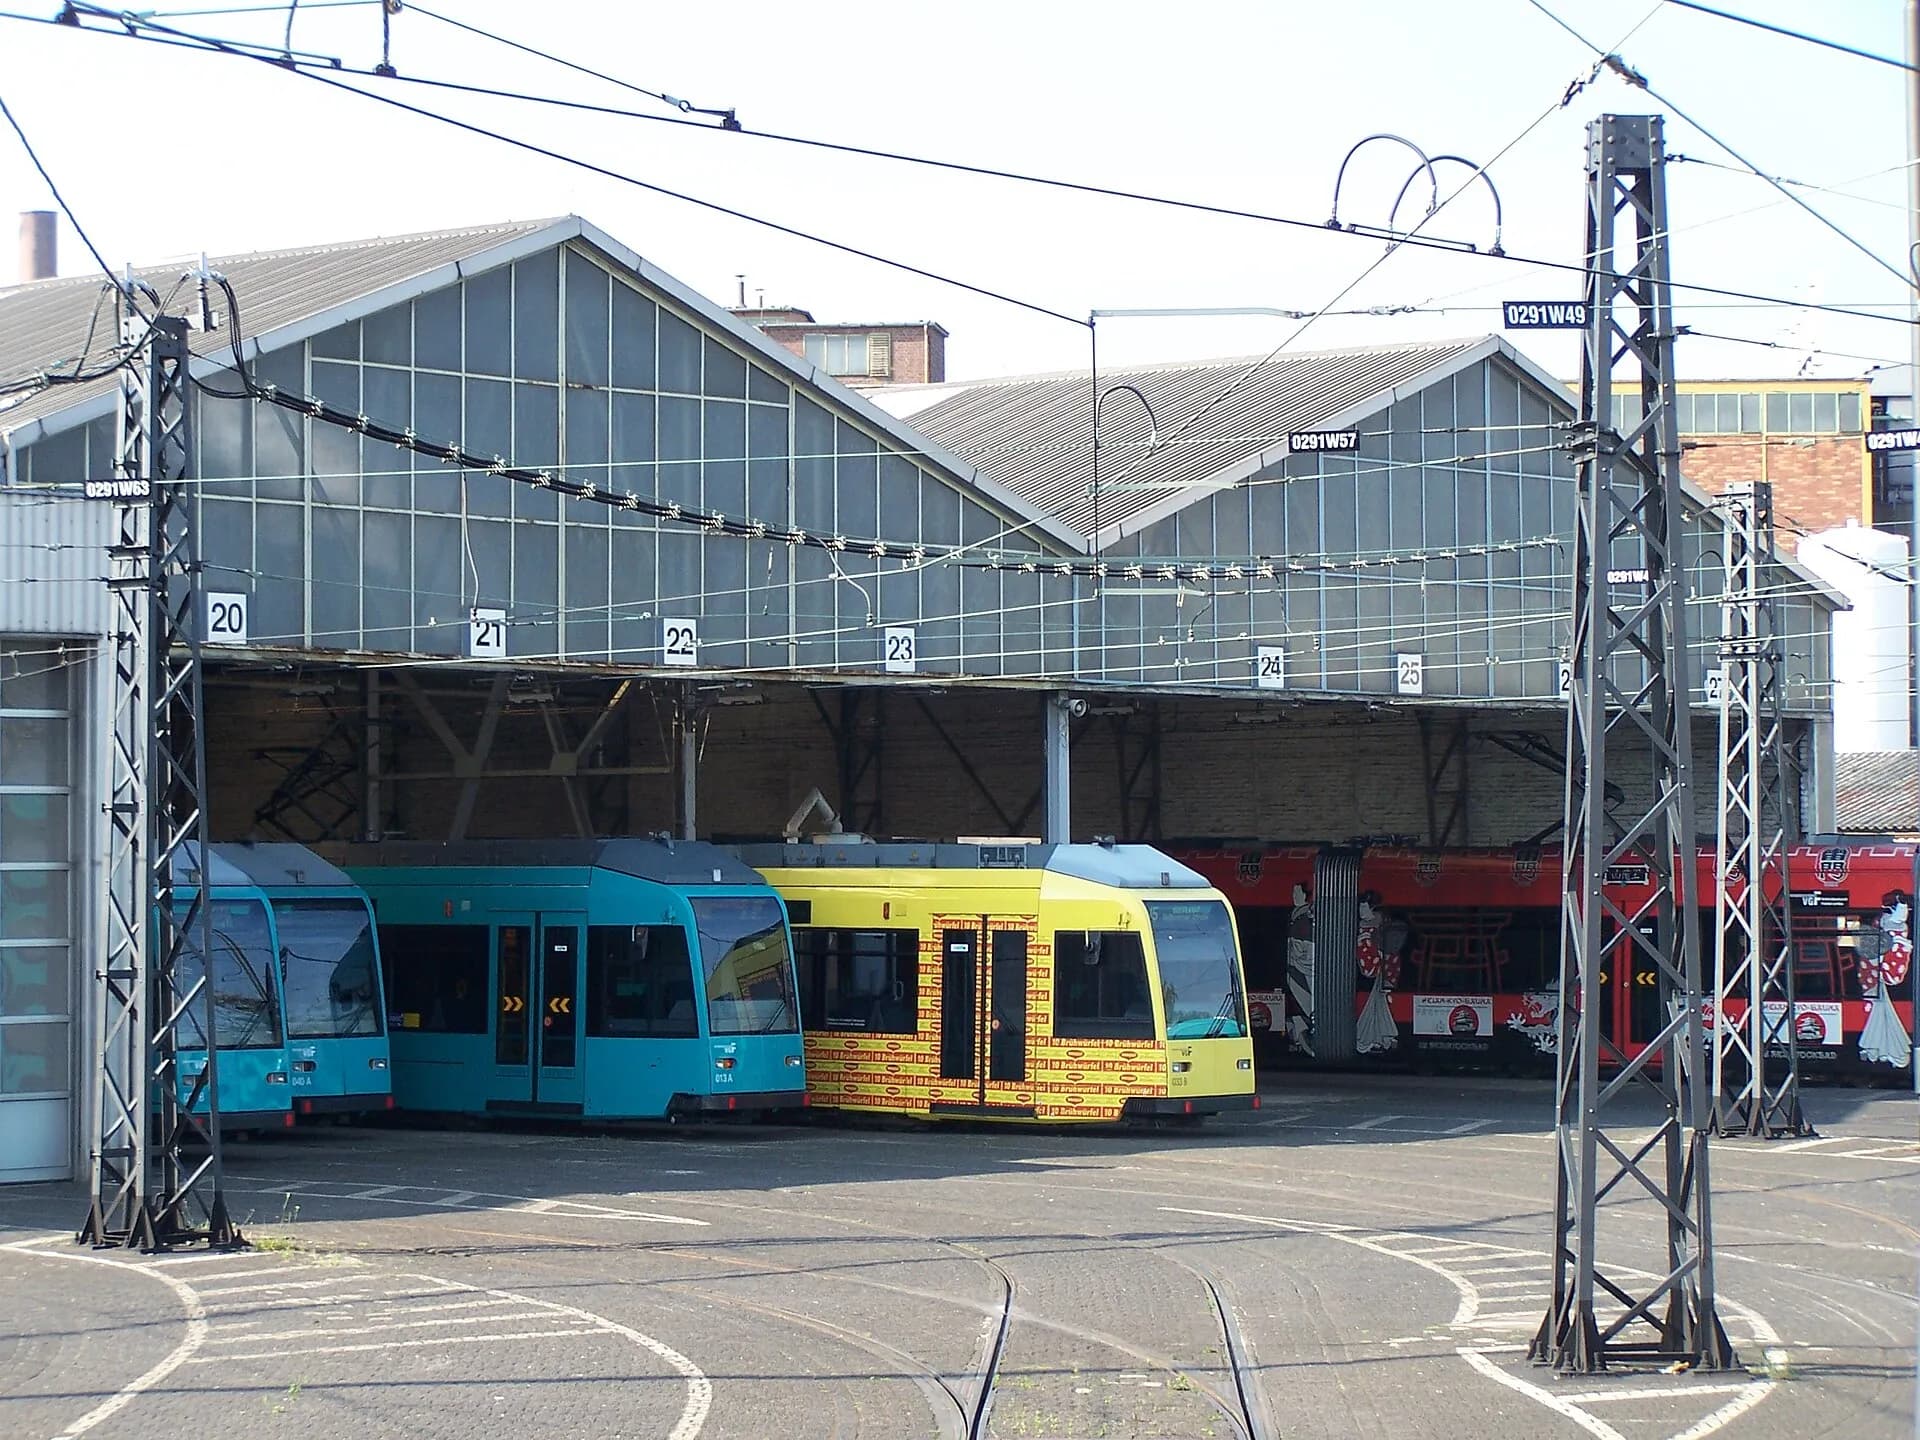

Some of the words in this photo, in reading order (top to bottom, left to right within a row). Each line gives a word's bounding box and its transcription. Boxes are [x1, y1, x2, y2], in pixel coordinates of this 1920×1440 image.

[1508, 304, 1586, 325] 0291W49
[1291, 432, 1357, 451] 0291W57
[1867, 431, 1920, 450] 0291W
[86, 481, 150, 498] 0291W63
[211, 602, 243, 633] 20
[475, 616, 501, 647] 21
[667, 627, 694, 655] 22
[888, 635, 913, 663] 23
[1261, 654, 1281, 679] 24
[1400, 661, 1421, 685] 25
[1561, 668, 1570, 691] 2
